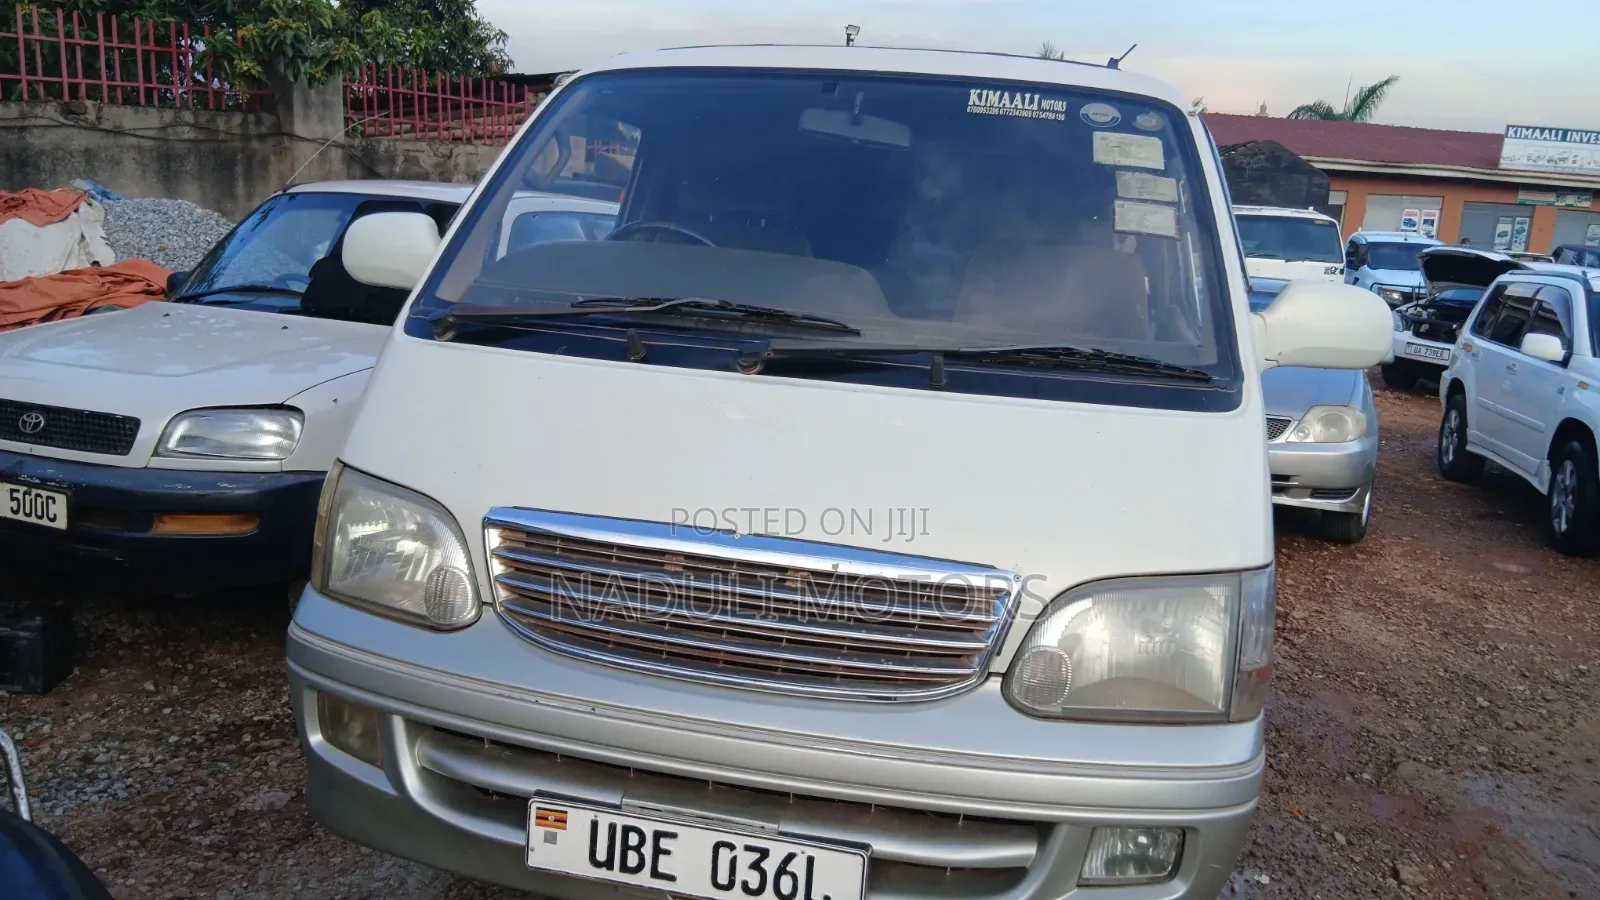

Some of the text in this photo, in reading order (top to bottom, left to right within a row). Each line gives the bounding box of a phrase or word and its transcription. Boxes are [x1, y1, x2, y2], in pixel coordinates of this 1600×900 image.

[968, 88, 1067, 112] KIMAALI MOTORS
[1507, 126, 1564, 141] KIMAALI
[9, 487, 58, 523] 500C
[588, 817, 832, 900] UBE 036L
